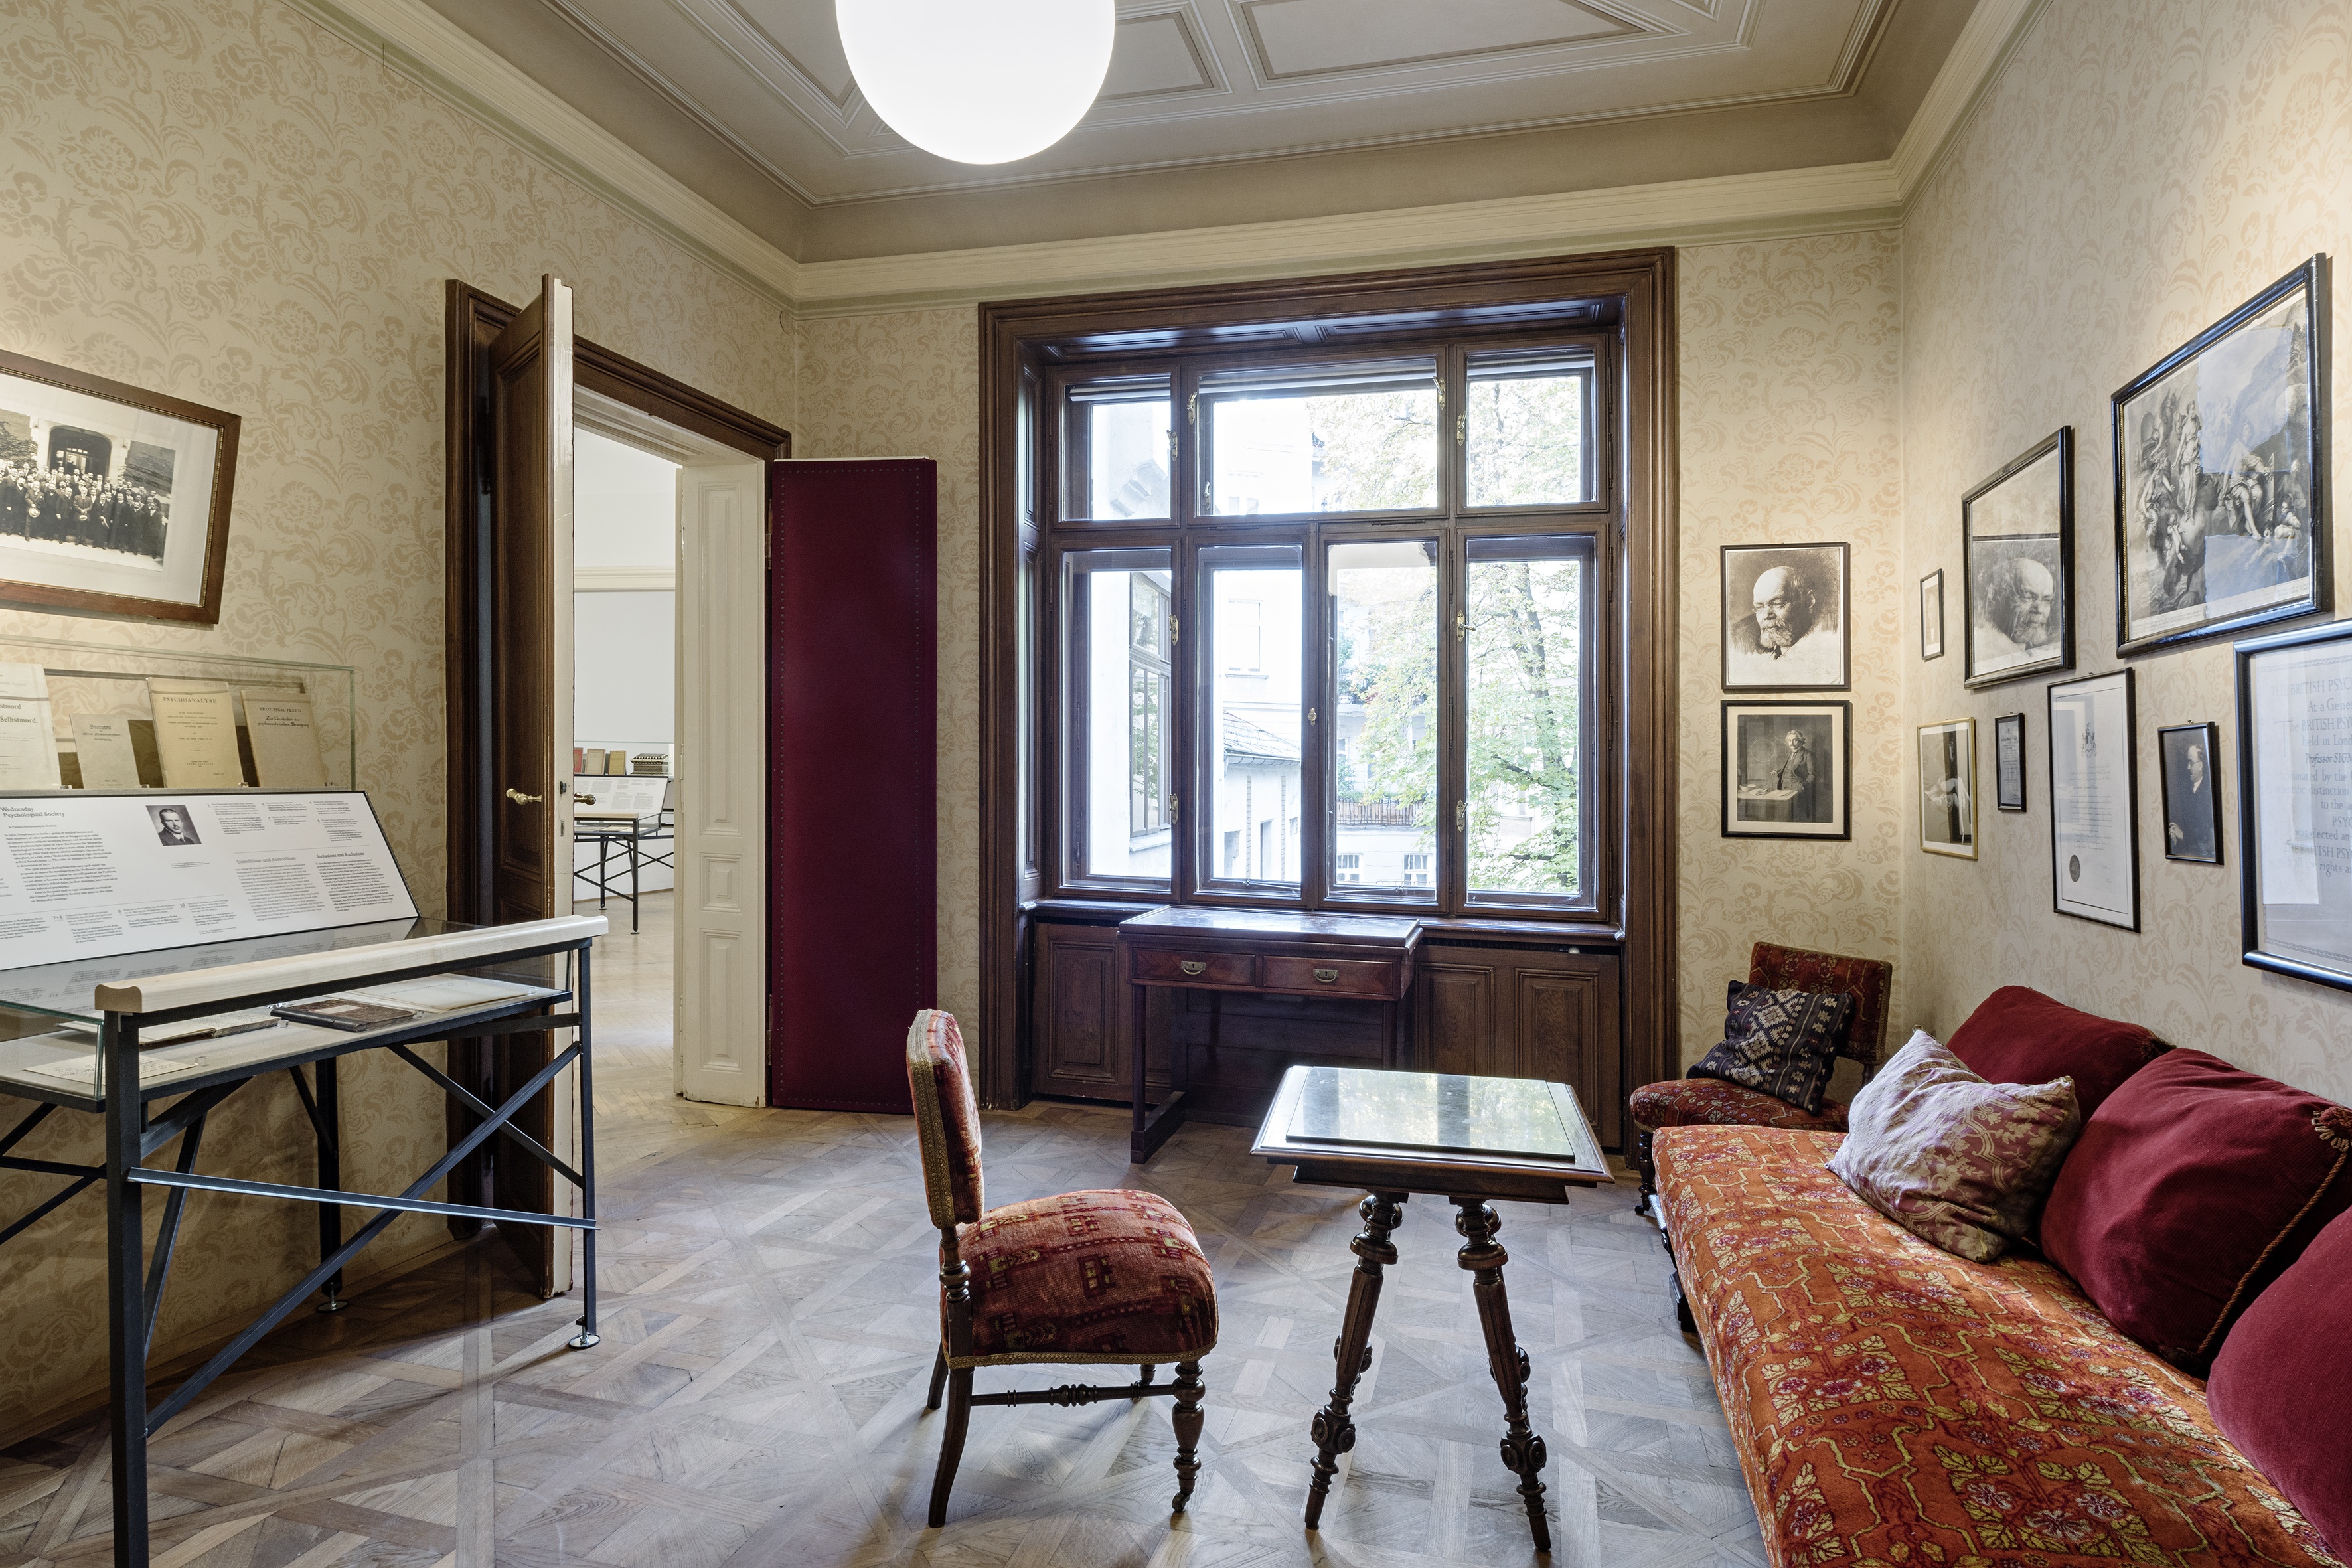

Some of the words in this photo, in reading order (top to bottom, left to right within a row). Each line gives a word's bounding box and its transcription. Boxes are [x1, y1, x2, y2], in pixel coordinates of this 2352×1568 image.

[2290, 680, 2324, 695] BRITISH
[2308, 700, 2317, 712] At
[2302, 718, 2334, 731] BRITISH
[2302, 734, 2319, 746] held
[2322, 738, 2330, 746] in
[2305, 753, 2333, 768] Professor
[2322, 769, 2331, 785] by
[2334, 769, 2347, 782] the
[2309, 784, 2349, 796] distinction
[2321, 801, 2329, 809] to
[2331, 798, 2343, 811] the
[2312, 828, 2338, 840] elected
[2319, 861, 2342, 878] rights
